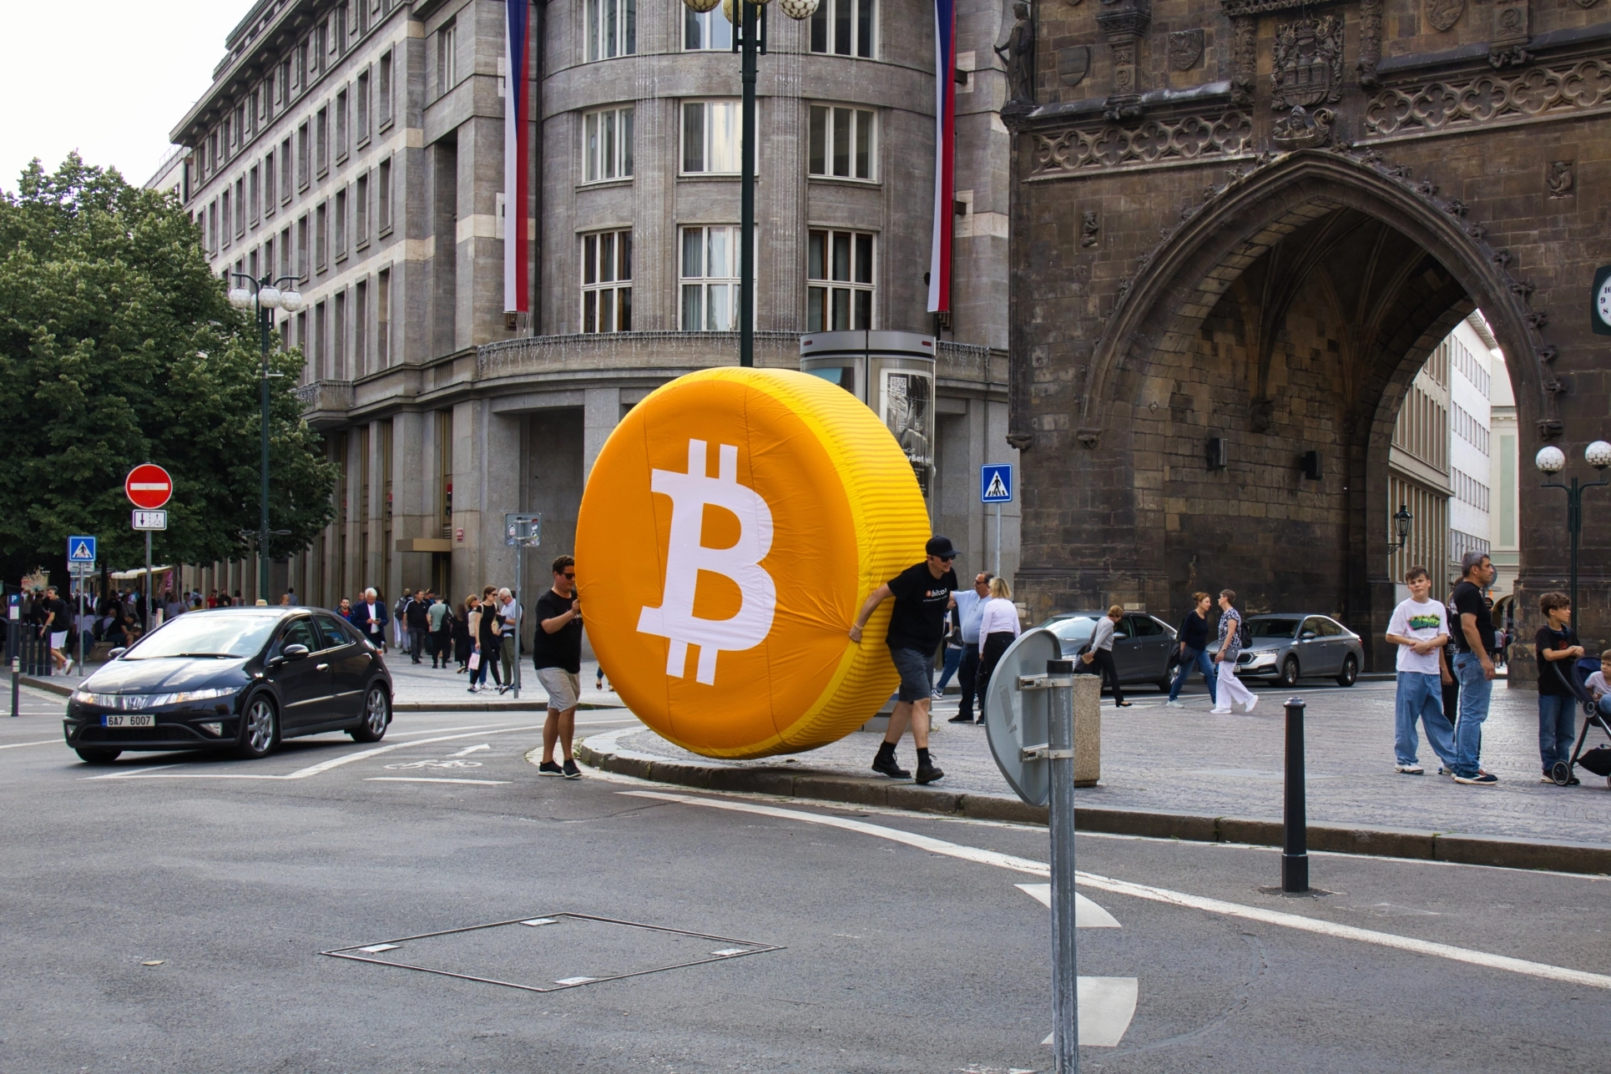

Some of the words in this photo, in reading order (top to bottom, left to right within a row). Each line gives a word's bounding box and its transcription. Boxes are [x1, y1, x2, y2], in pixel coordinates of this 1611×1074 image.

[1602, 307, 1609, 315] 8
[11, 595, 18, 603] P
[108, 716, 124, 726] 6A7
[130, 716, 151, 726] 6007
